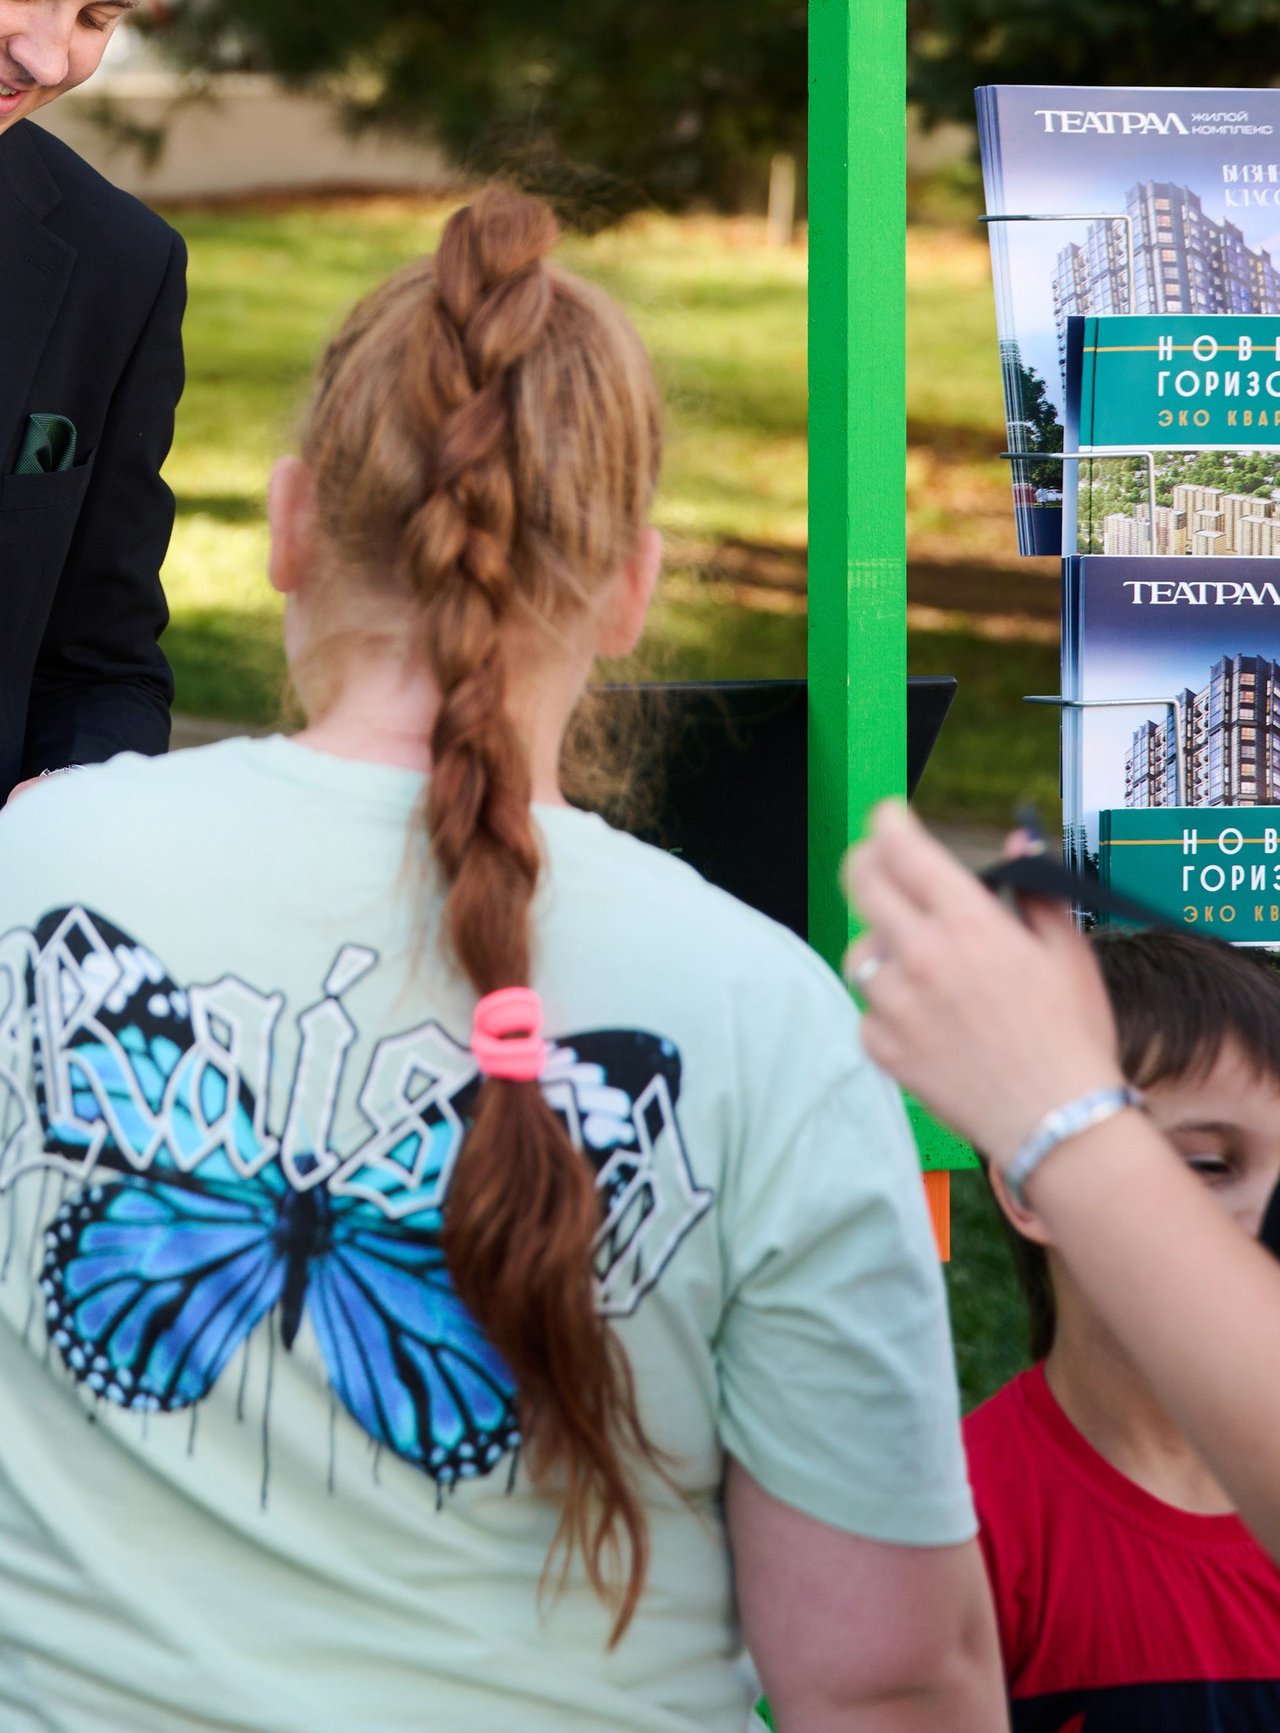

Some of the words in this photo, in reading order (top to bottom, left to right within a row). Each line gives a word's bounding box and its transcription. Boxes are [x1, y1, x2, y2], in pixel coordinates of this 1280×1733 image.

[1034, 110, 1190, 135] ТЕАТРАЛ
[1191, 111, 1249, 122] ЖИЛОЙ
[1191, 125, 1274, 135] КОМПЛЕКС
[1158, 335, 1280, 362] НОВ
[1158, 409, 1210, 427] ЭКО
[1122, 581, 1280, 606] ТЕАТРАЛ
[1183, 905, 1236, 923] ЭКО
[1254, 904, 1280, 922] КВ
